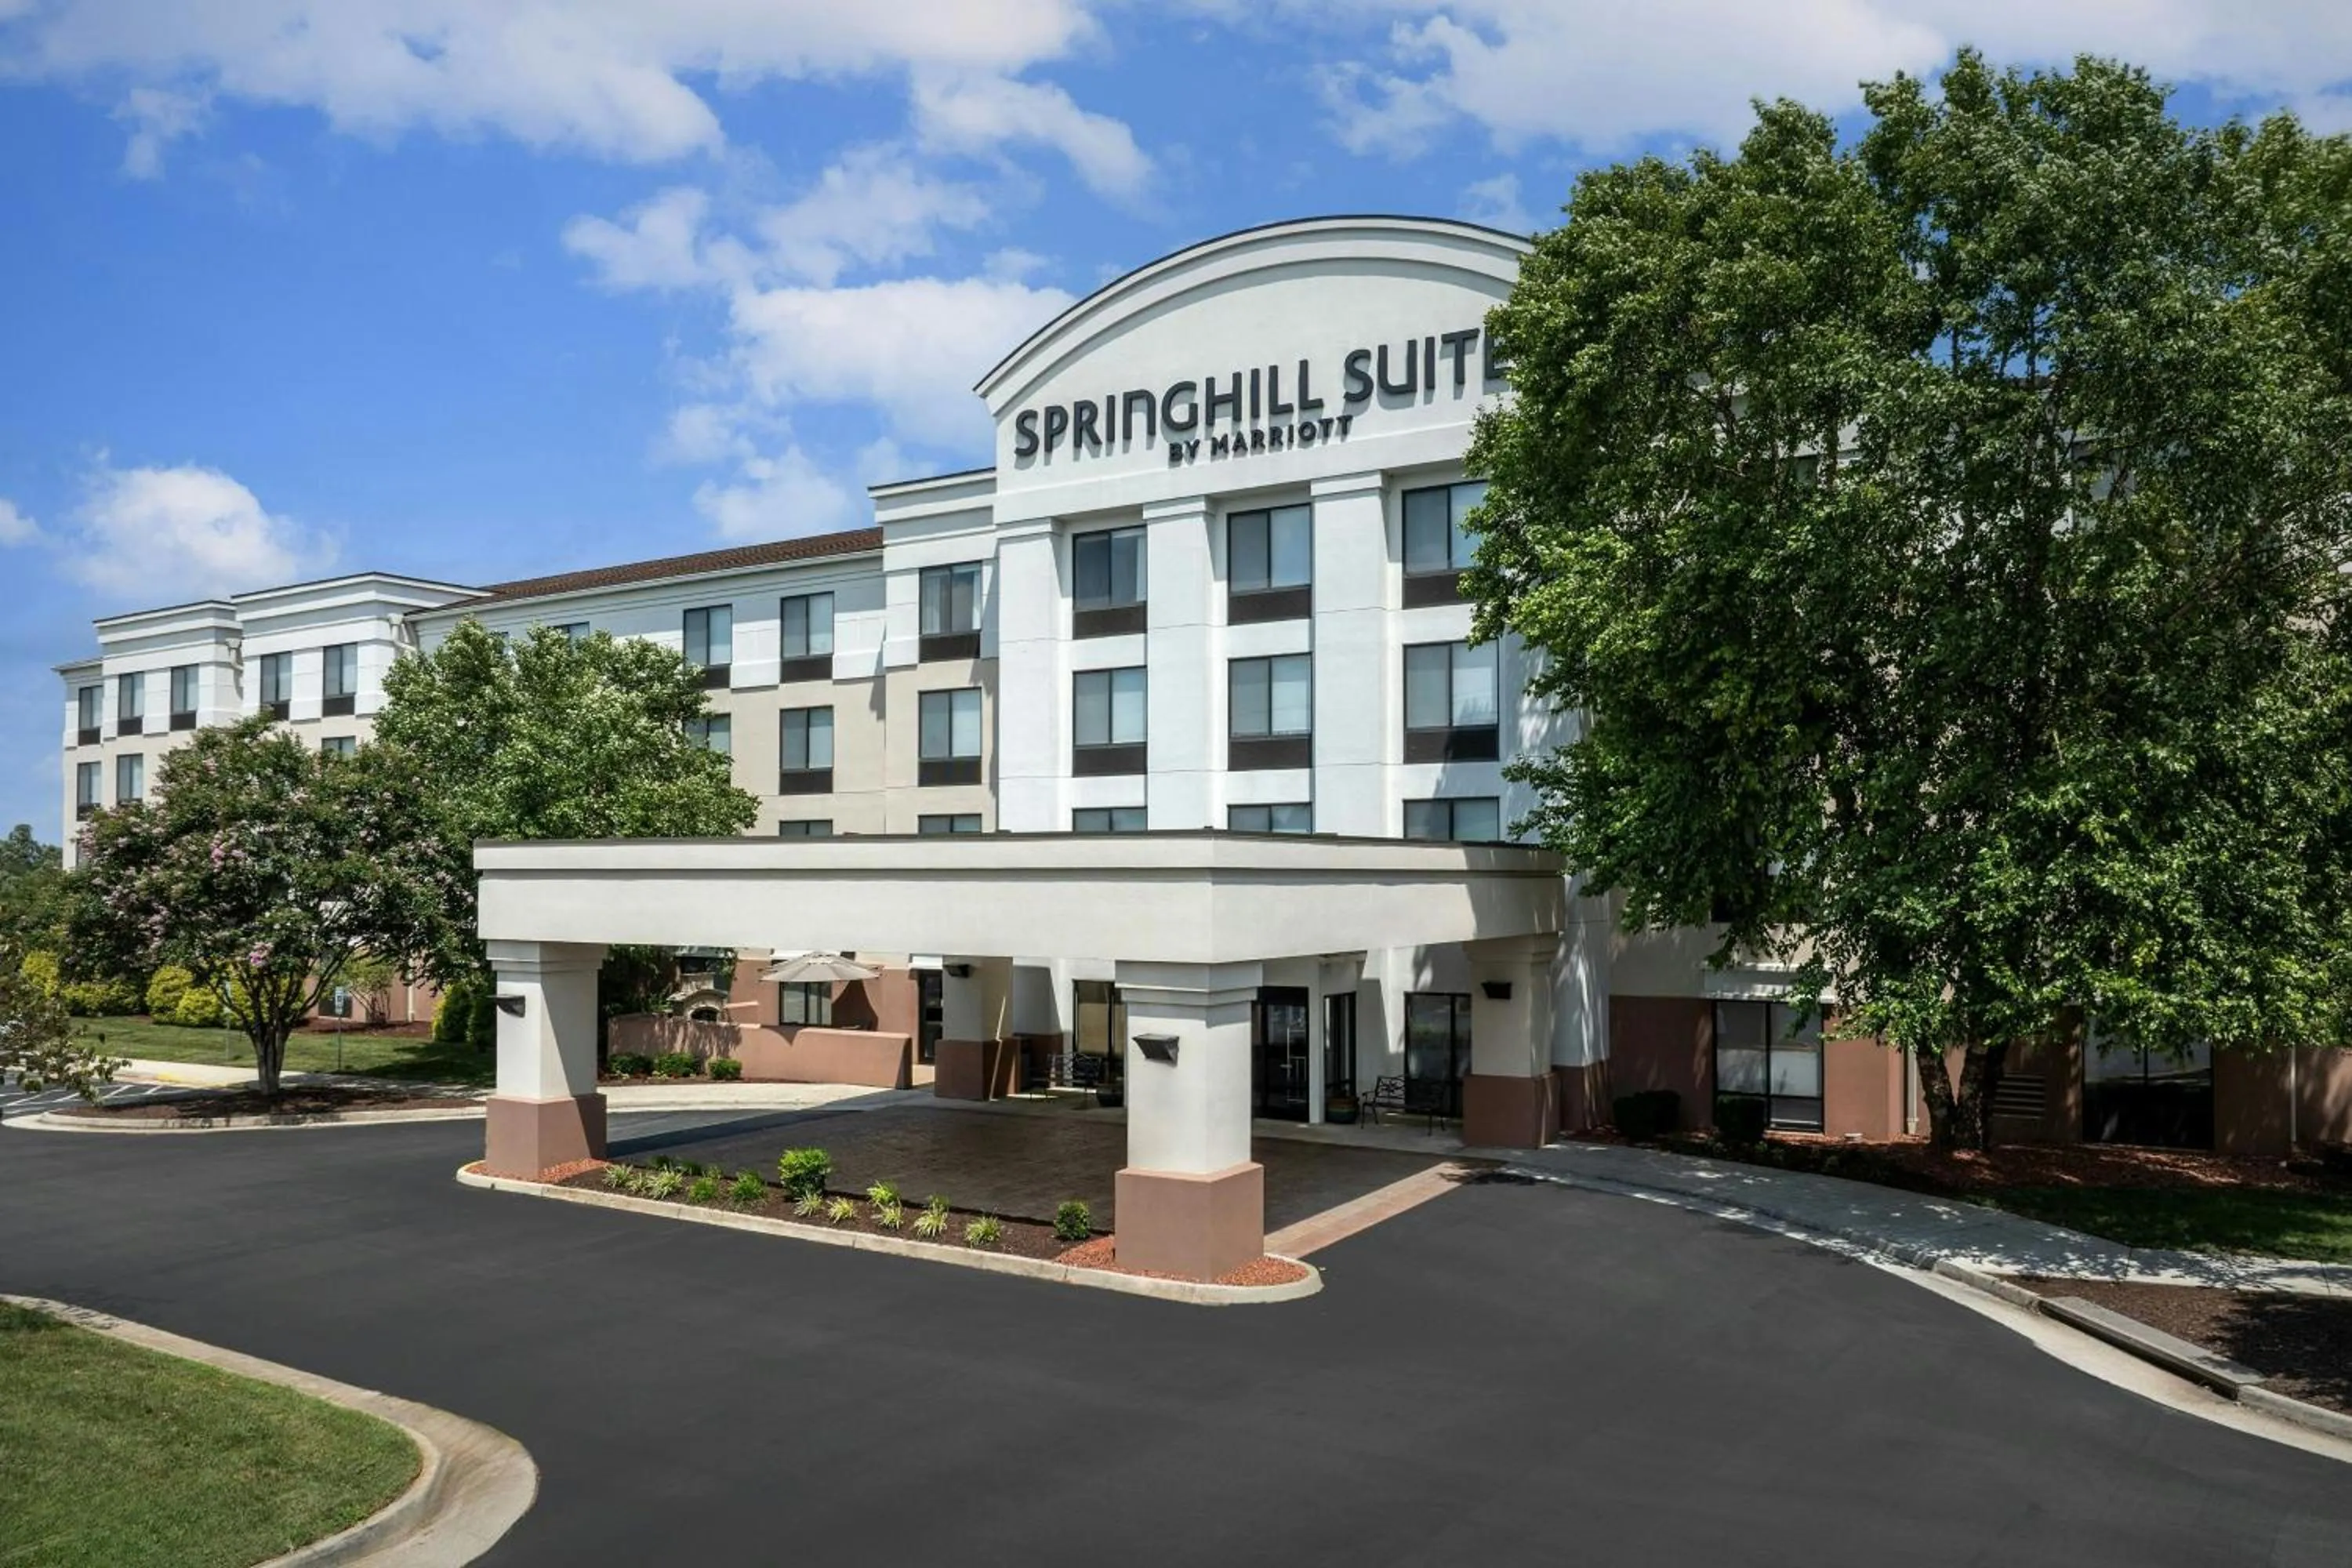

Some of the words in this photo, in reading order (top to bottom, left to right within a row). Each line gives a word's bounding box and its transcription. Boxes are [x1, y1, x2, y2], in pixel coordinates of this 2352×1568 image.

[1014, 358, 1323, 456] SPRINGHILL
[1169, 439, 1200, 462] BY
[1211, 414, 1353, 456] MARRIOTT
